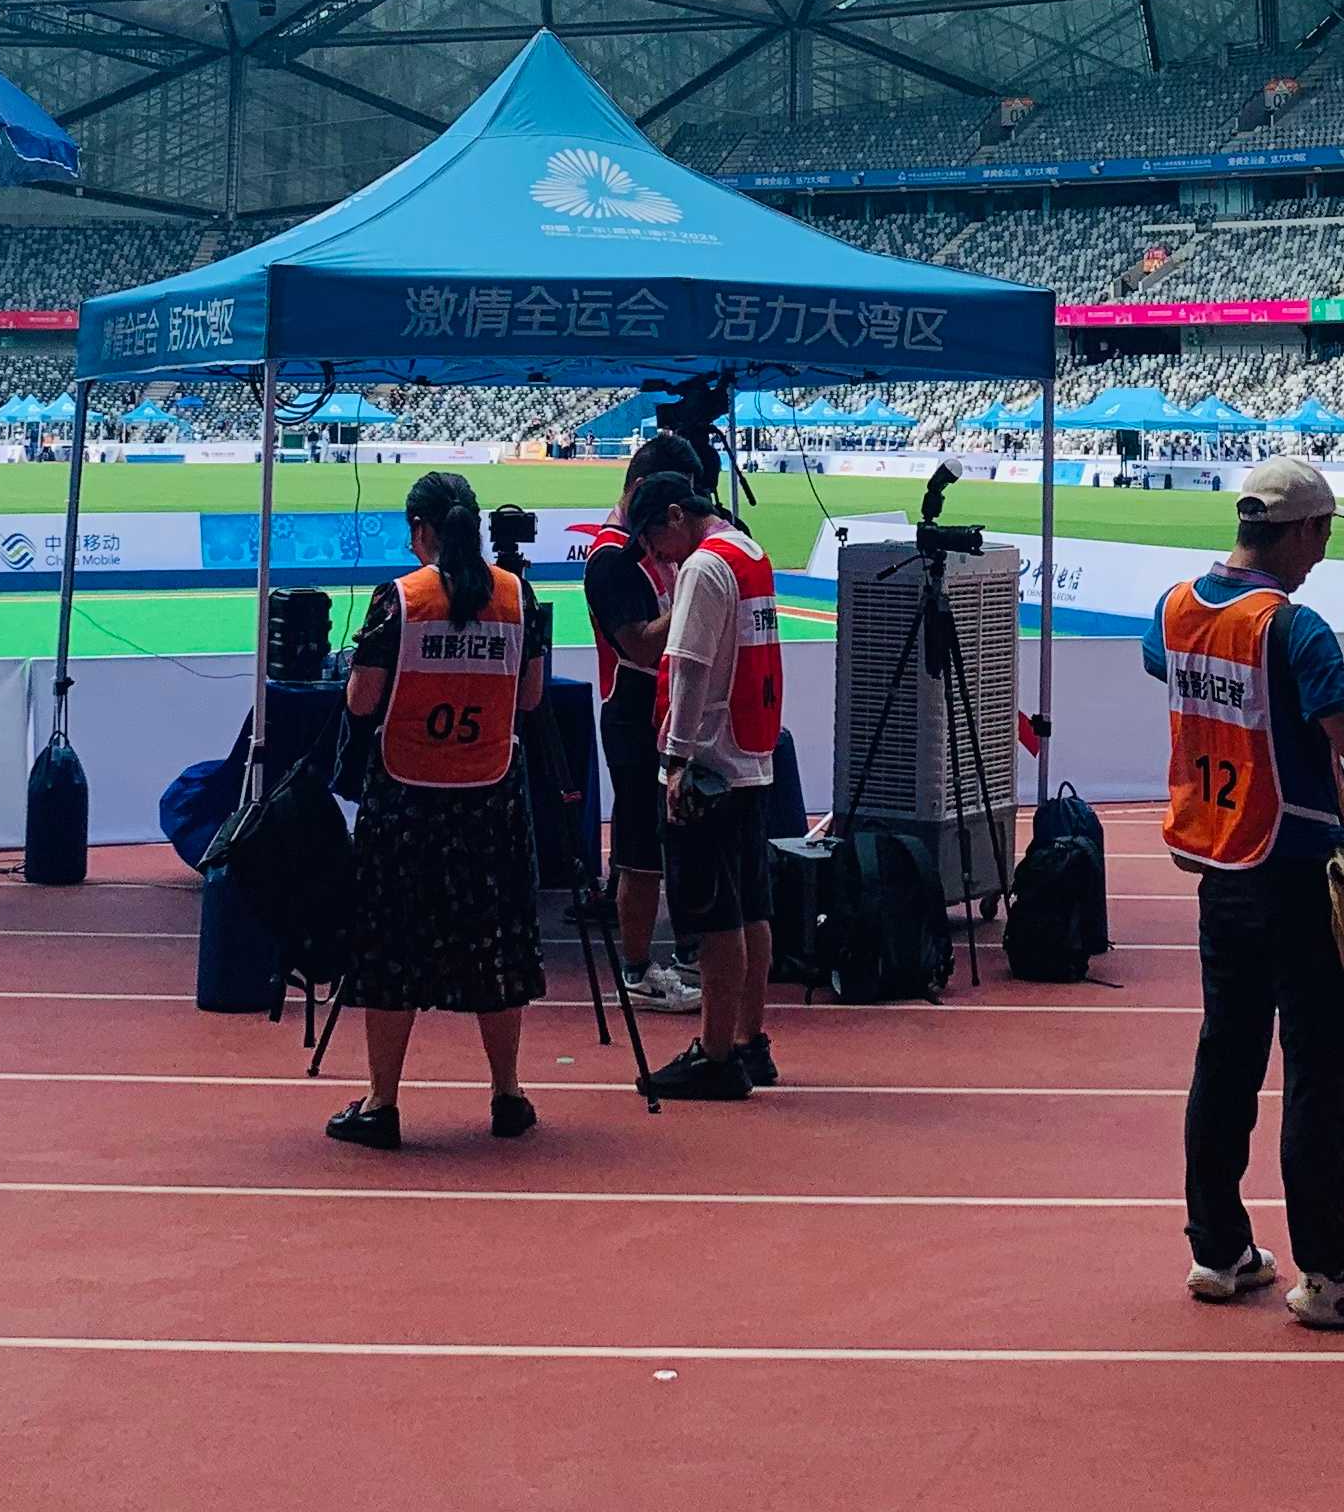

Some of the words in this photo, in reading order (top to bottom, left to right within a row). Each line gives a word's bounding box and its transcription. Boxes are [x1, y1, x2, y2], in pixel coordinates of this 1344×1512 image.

[166, 297, 236, 352] 活力大湾区
[400, 285, 670, 339] 激情全运会
[707, 291, 949, 353] 活力大湾区
[45, 533, 121, 553] 中移动
[566, 544, 594, 561] AN
[82, 554, 121, 567] Mobile
[422, 634, 507, 660] 摄影记者
[426, 702, 482, 745] 05
[1194, 754, 1238, 810] 12
